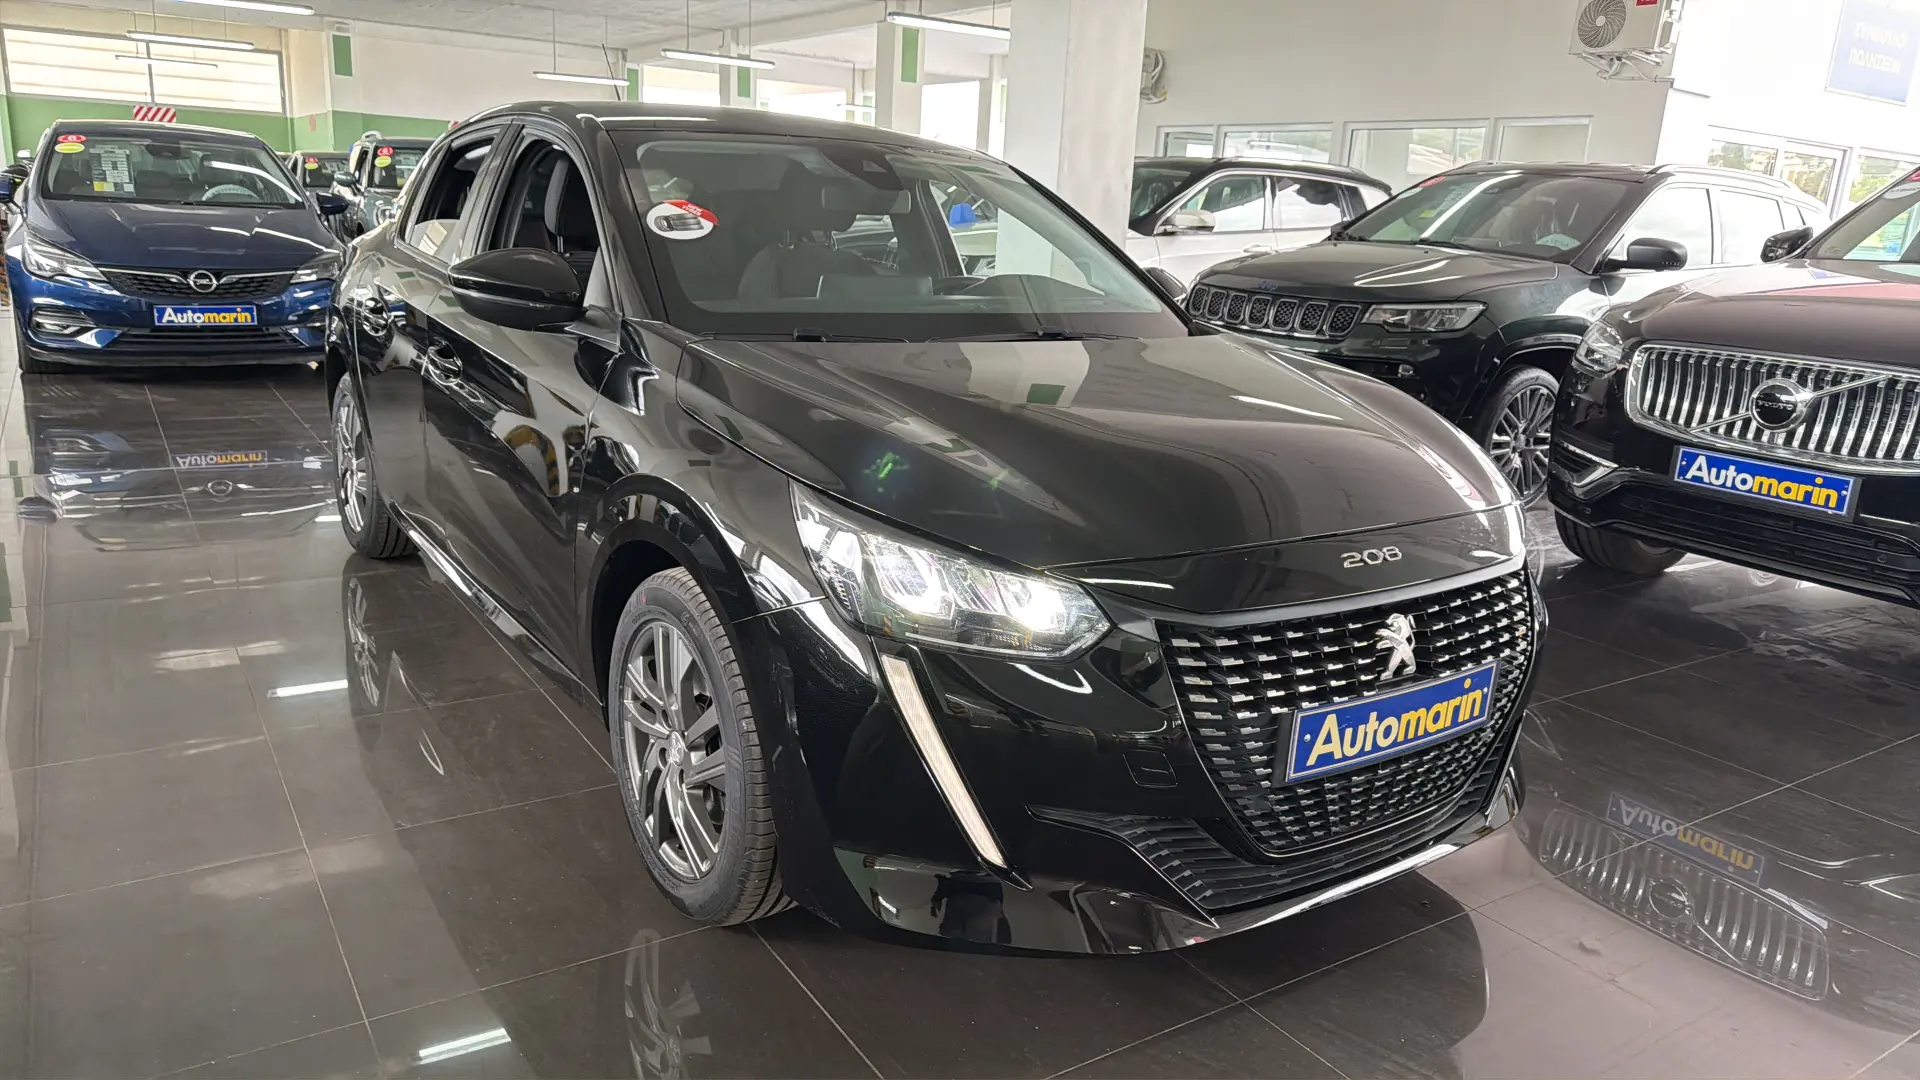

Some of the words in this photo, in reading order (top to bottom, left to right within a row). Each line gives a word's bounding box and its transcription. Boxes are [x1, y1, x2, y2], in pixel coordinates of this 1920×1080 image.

[162, 307, 252, 324] Automarin
[1685, 455, 1838, 508] Automarin
[1340, 546, 1402, 568] 208
[1305, 677, 1482, 766] Automarin
